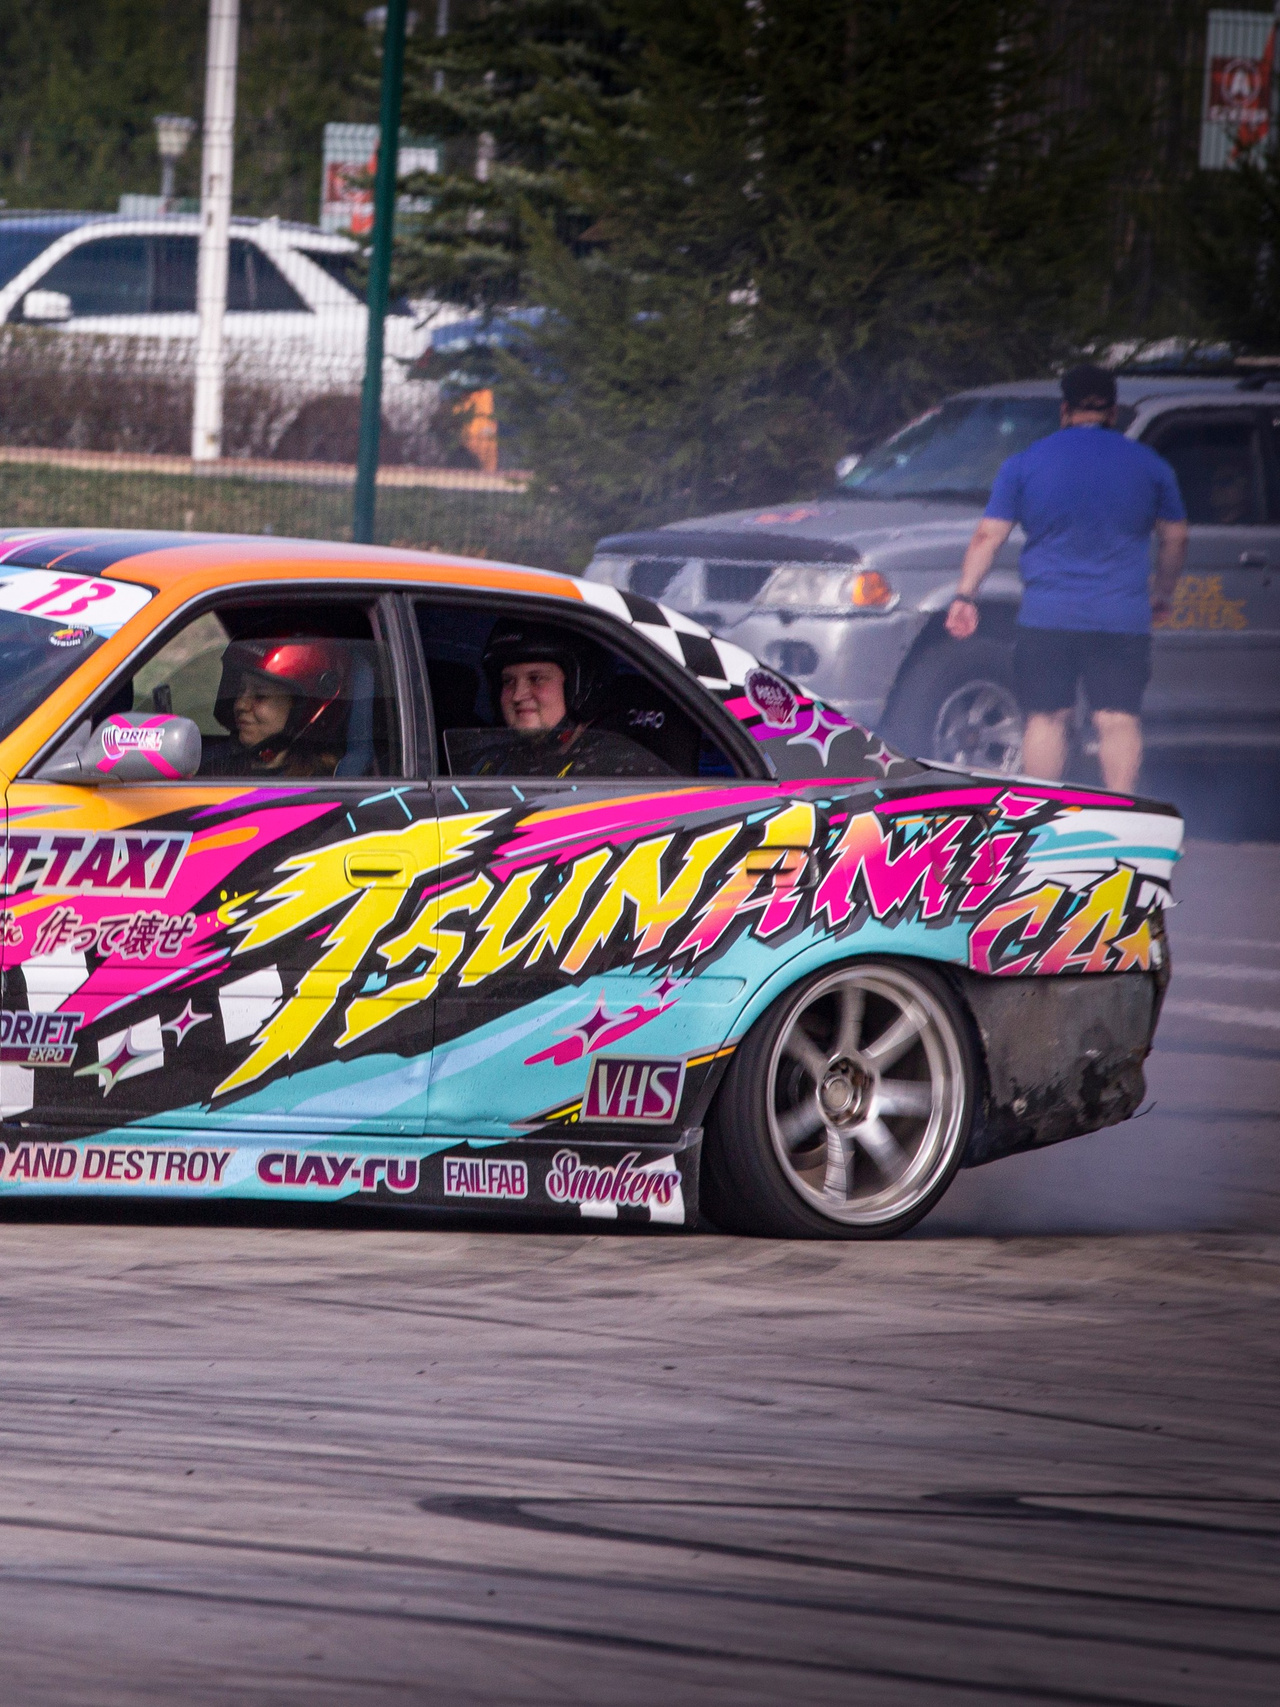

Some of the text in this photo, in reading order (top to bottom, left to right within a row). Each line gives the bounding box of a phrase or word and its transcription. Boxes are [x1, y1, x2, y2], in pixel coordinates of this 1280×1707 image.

[16, 577, 117, 617] 13
[120, 729, 163, 742] DRIFT
[42, 836, 184, 891] TAXI
[31, 908, 194, 956] 作って壊せ
[27, 1048, 65, 1063] EXPO
[596, 1063, 678, 1118] VHS
[9, 1145, 78, 1179] AND
[82, 1148, 231, 1182] DESTROY
[548, 1153, 679, 1204] Smokers
